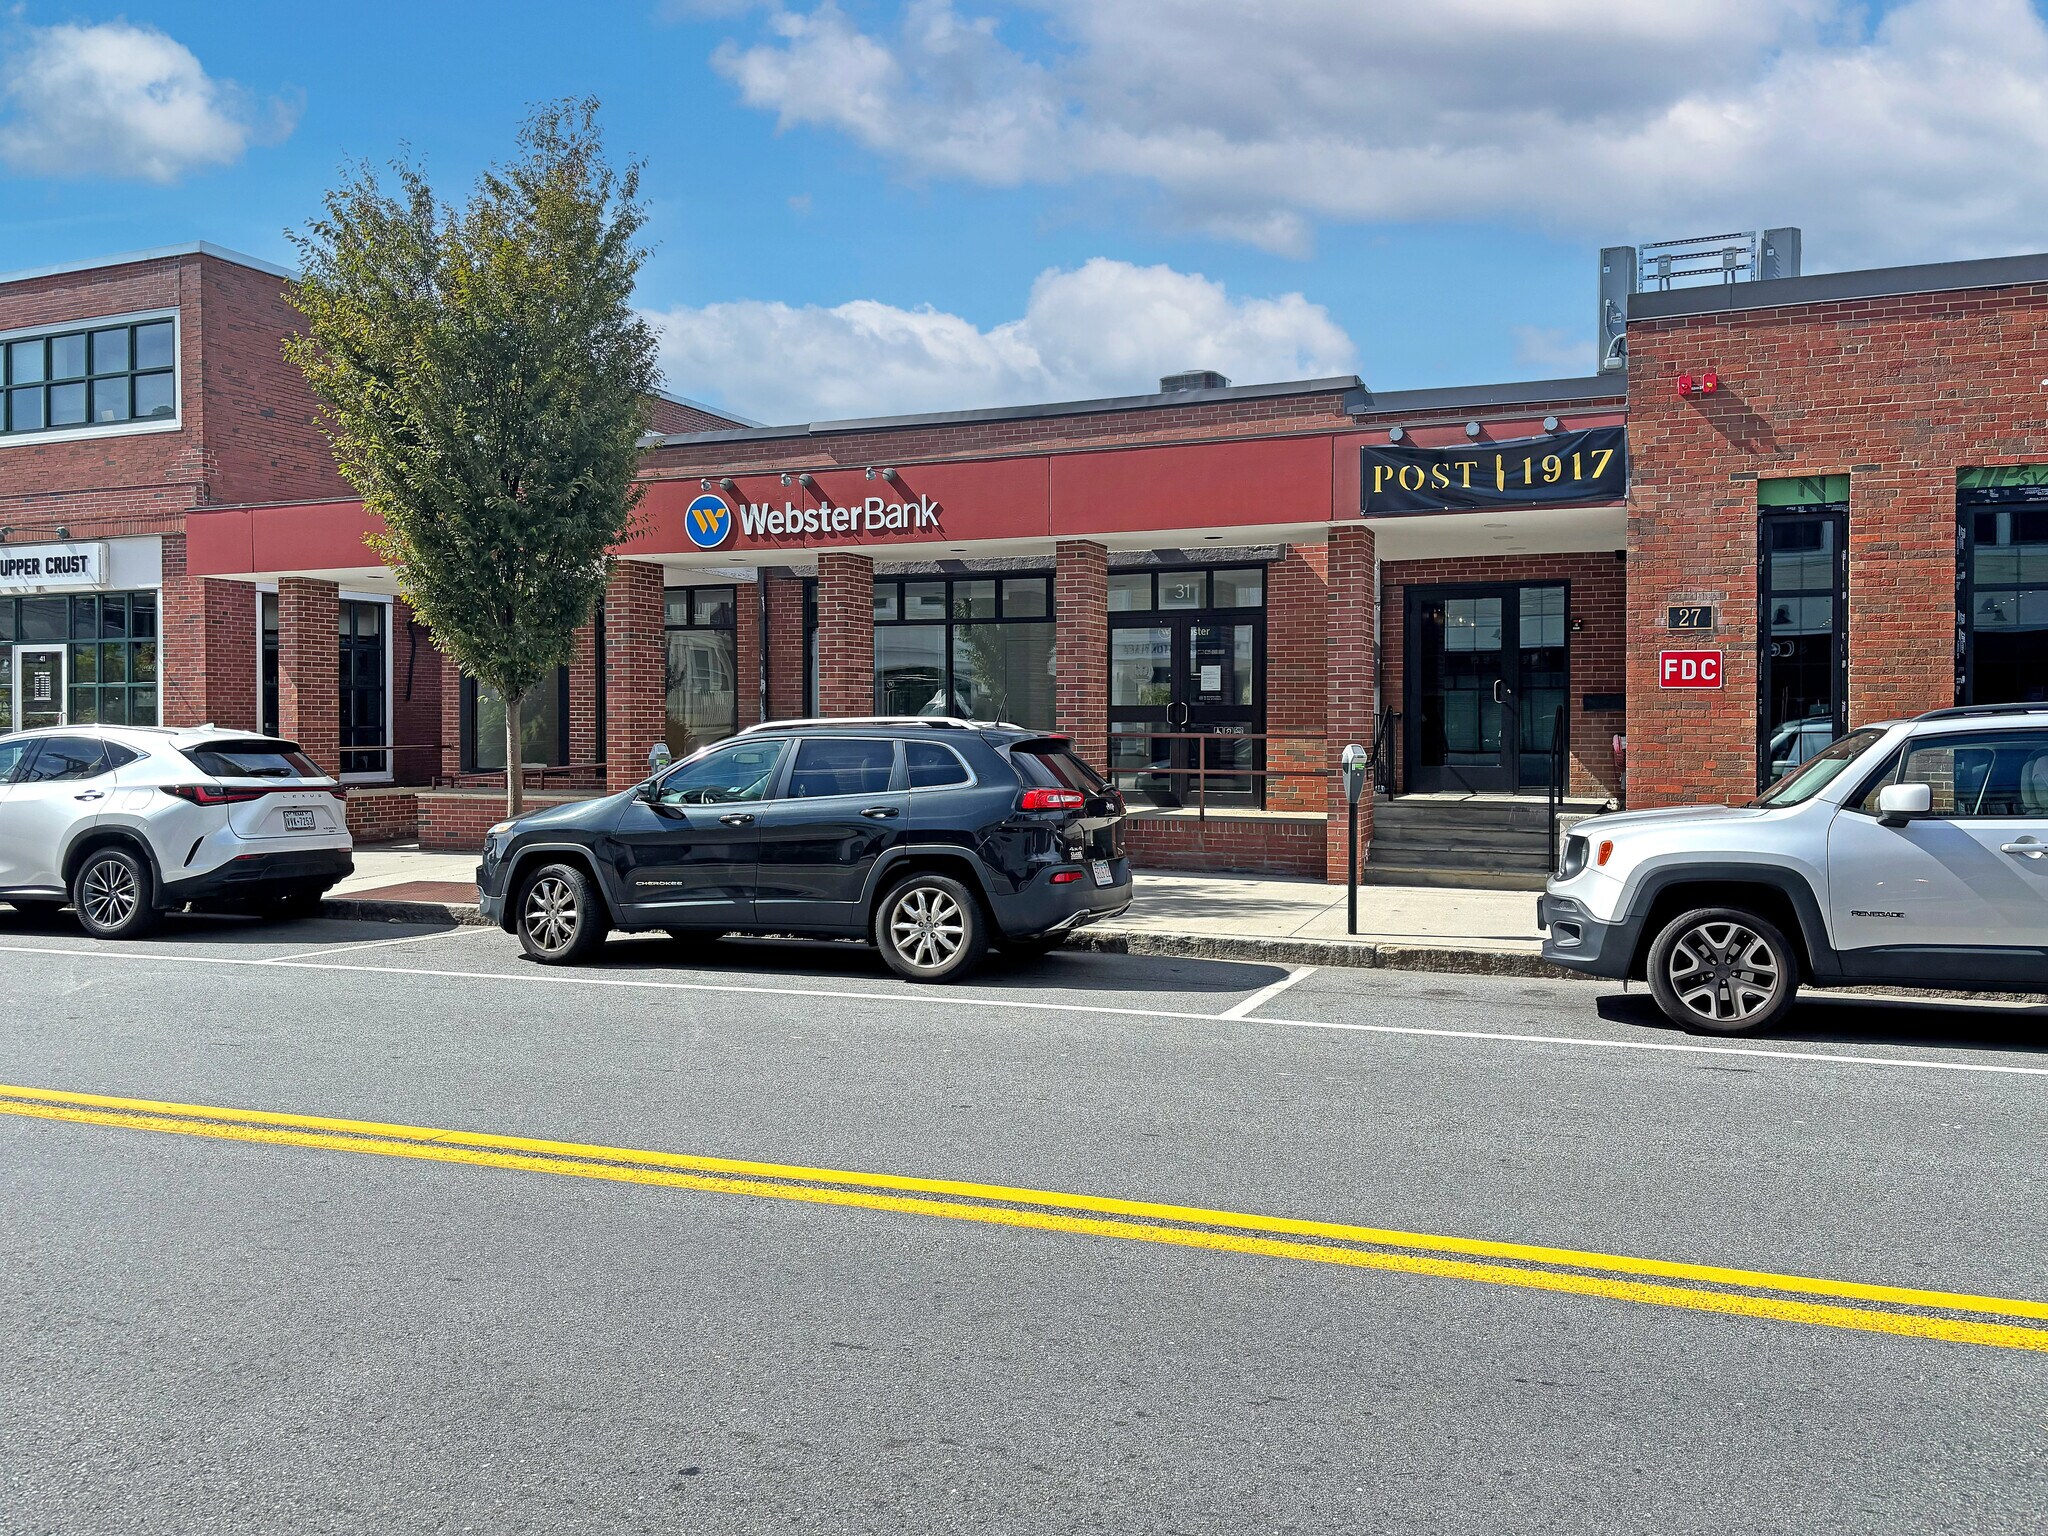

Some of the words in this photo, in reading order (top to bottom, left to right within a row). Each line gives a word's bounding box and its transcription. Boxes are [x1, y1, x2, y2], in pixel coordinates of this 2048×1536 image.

[1373, 461, 1478, 493] POST
[1522, 449, 1614, 485] 1917
[0, 558, 40, 576] UPPER
[45, 555, 88, 574] CRUST
[1175, 584, 1190, 599] 31
[1678, 608, 1701, 627] 27
[1664, 658, 1717, 680] FDC
[1851, 910, 1905, 918] RENEGADE
